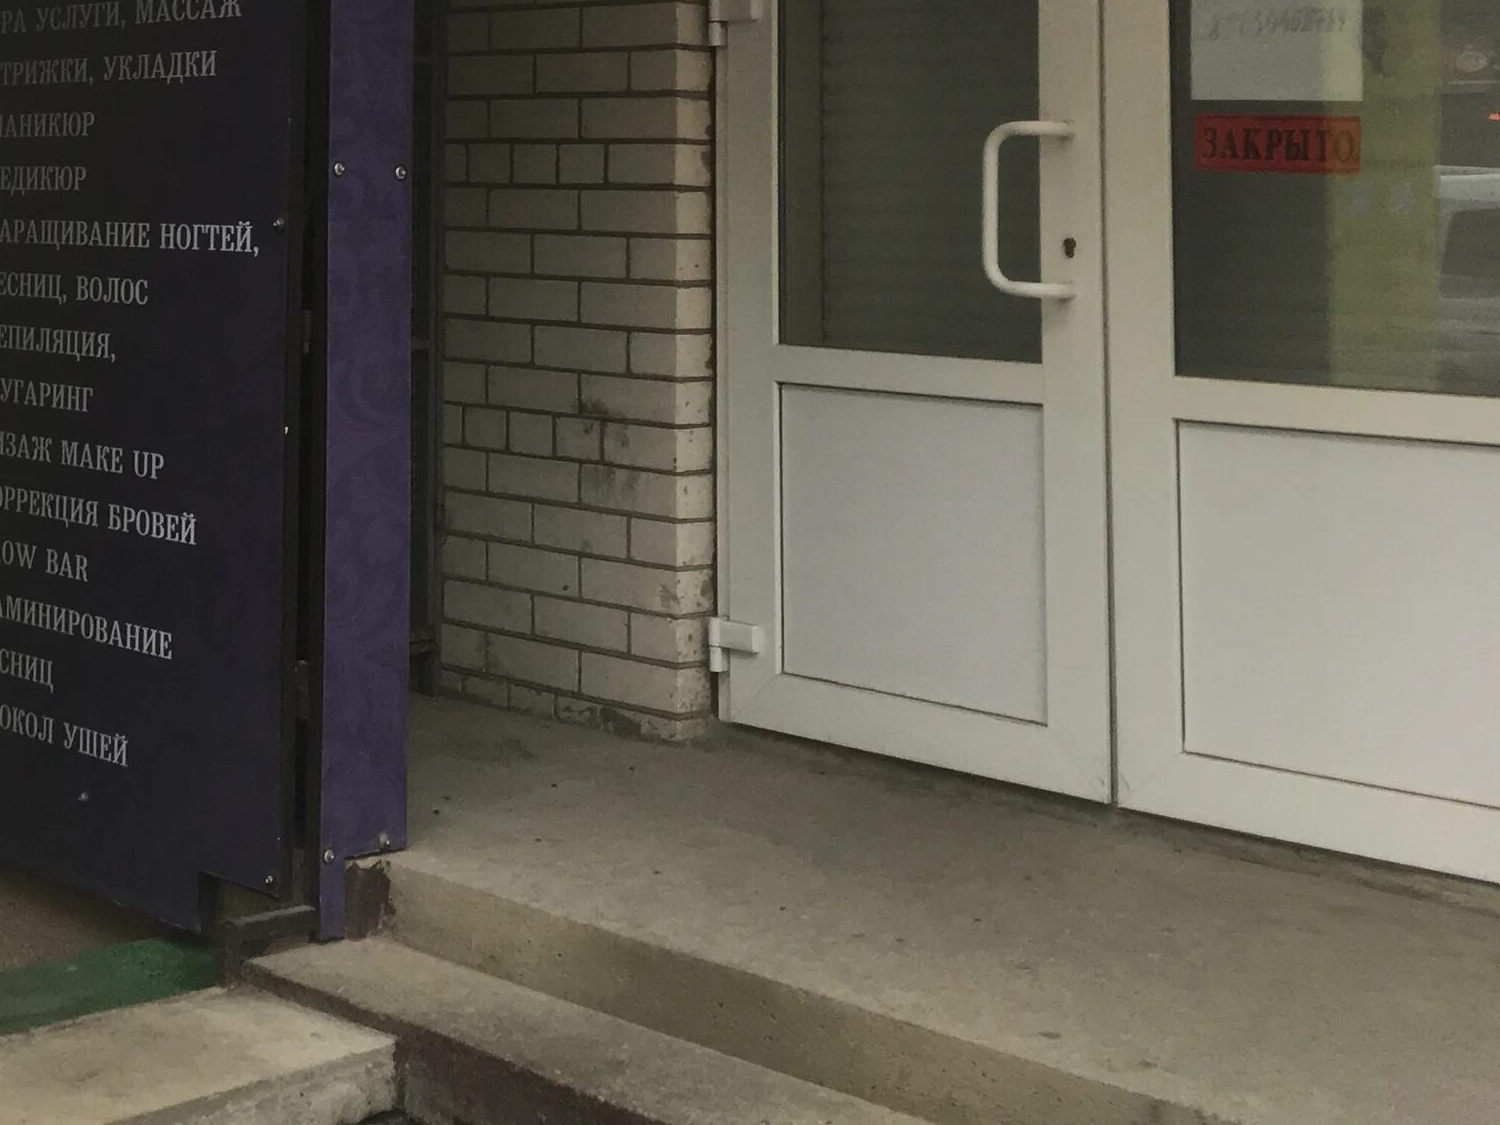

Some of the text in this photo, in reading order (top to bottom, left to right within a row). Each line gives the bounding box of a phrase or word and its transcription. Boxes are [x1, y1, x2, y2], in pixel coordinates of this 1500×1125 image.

[36, 1, 126, 31] УСЛУГИ,
[103, 50, 218, 85] УКЛАДКИ
[1201, 128, 1356, 164] ЗАКРЫТО
[159, 221, 259, 257] НОГТЕЙ,
[76, 276, 148, 305] ВОЛОС
[60, 440, 123, 474] MAKE
[133, 450, 164, 480] UP
[108, 503, 196, 546] БРОВЕЙ
[46, 548, 88, 582] BAR
[63, 722, 128, 767] УШЕЙ
